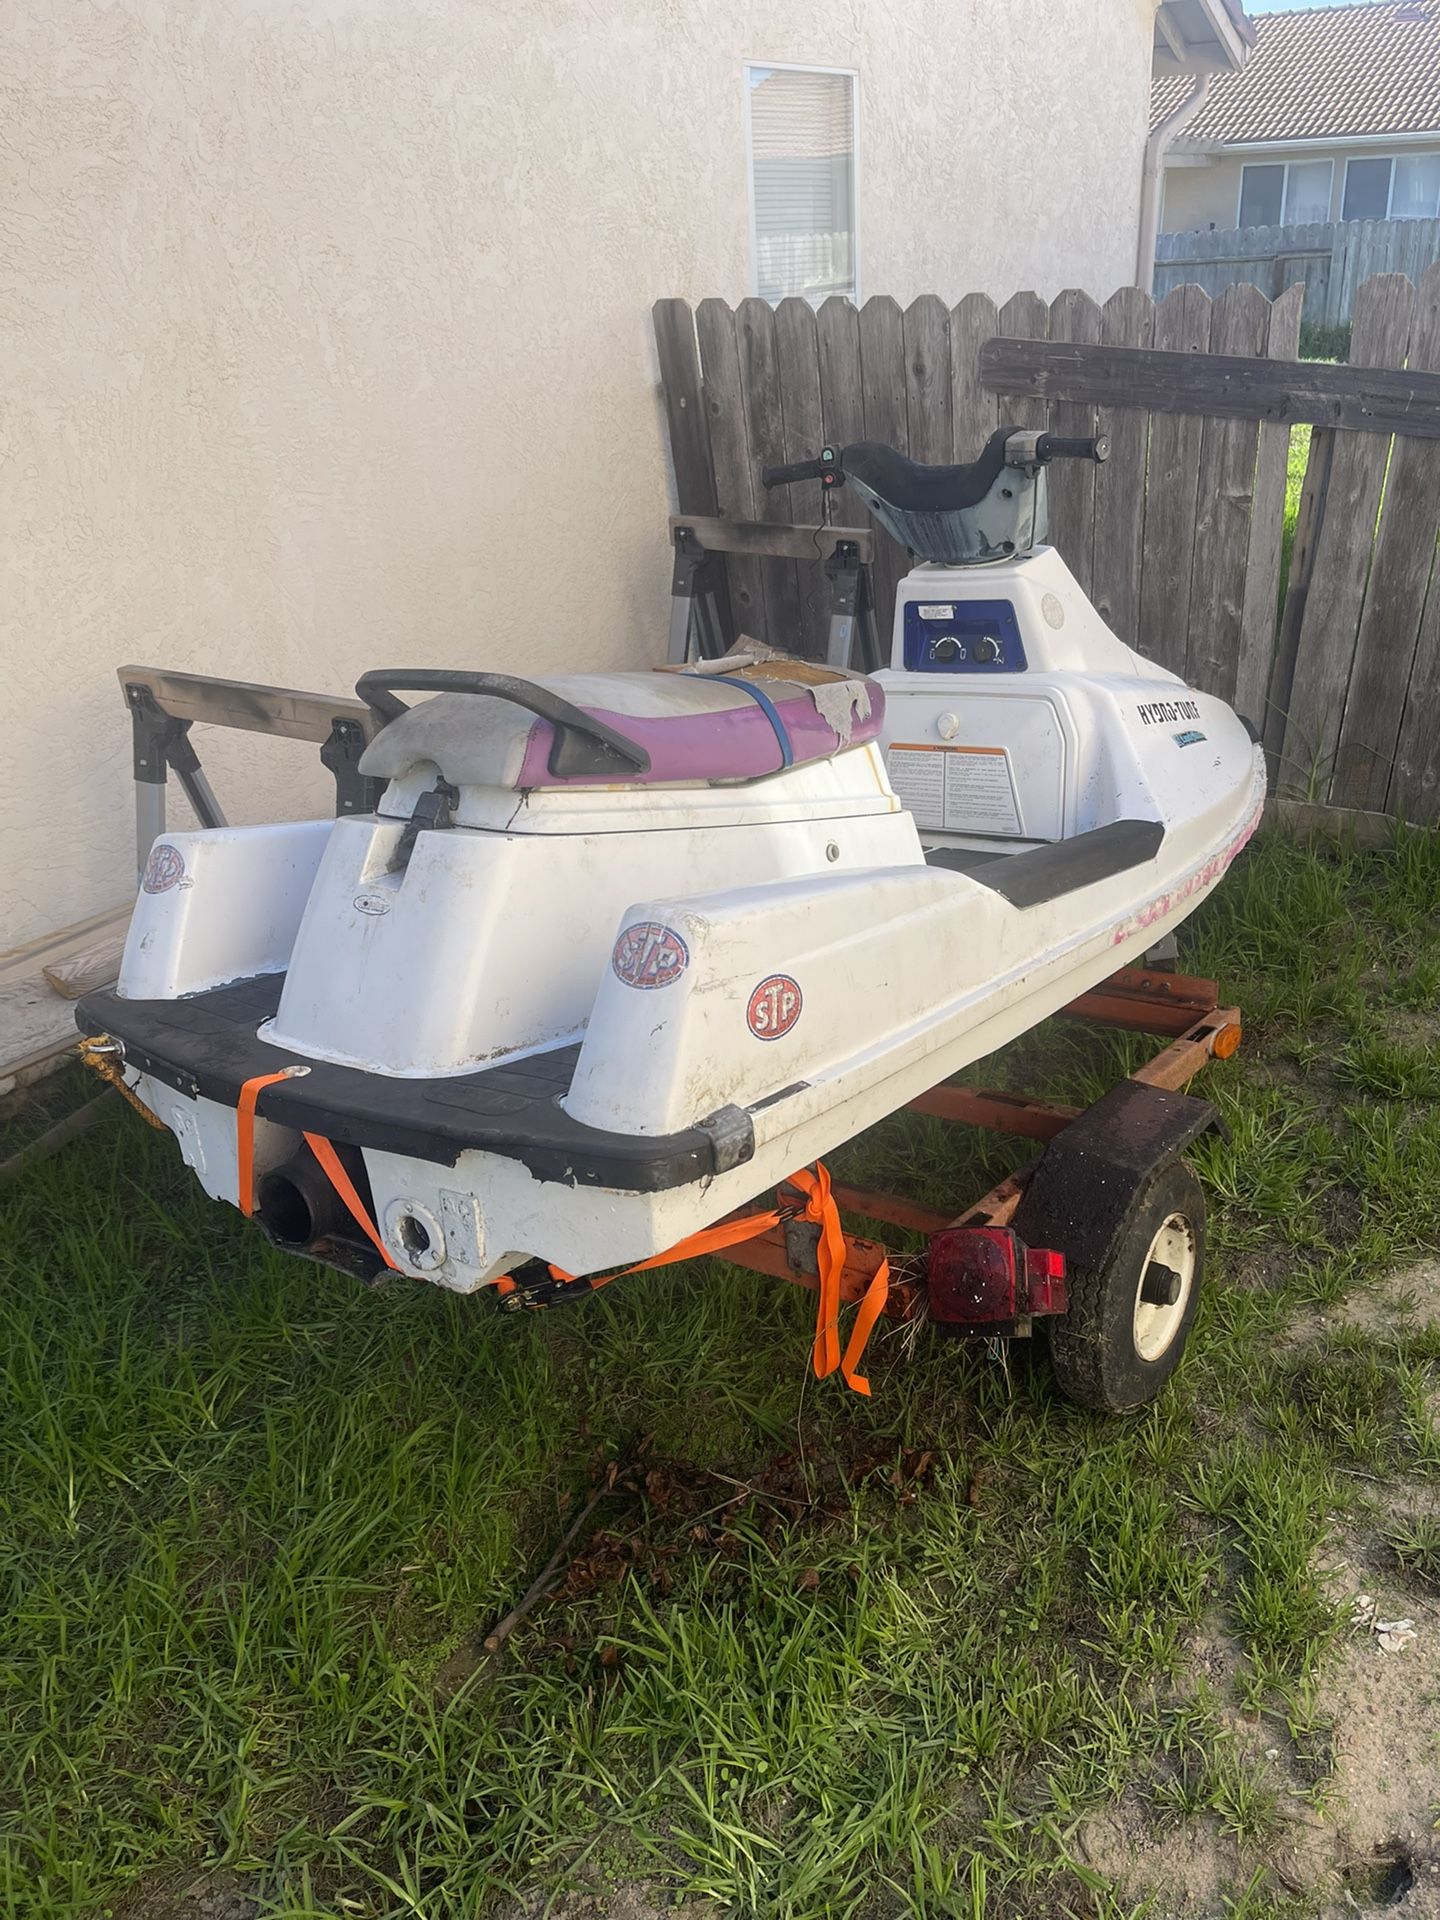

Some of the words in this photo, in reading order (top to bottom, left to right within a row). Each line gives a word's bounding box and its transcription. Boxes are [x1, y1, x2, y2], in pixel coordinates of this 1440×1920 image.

[1137, 701, 1200, 725] HYDRO-TURF
[618, 931, 678, 977] STP
[755, 983, 797, 1031] STP
